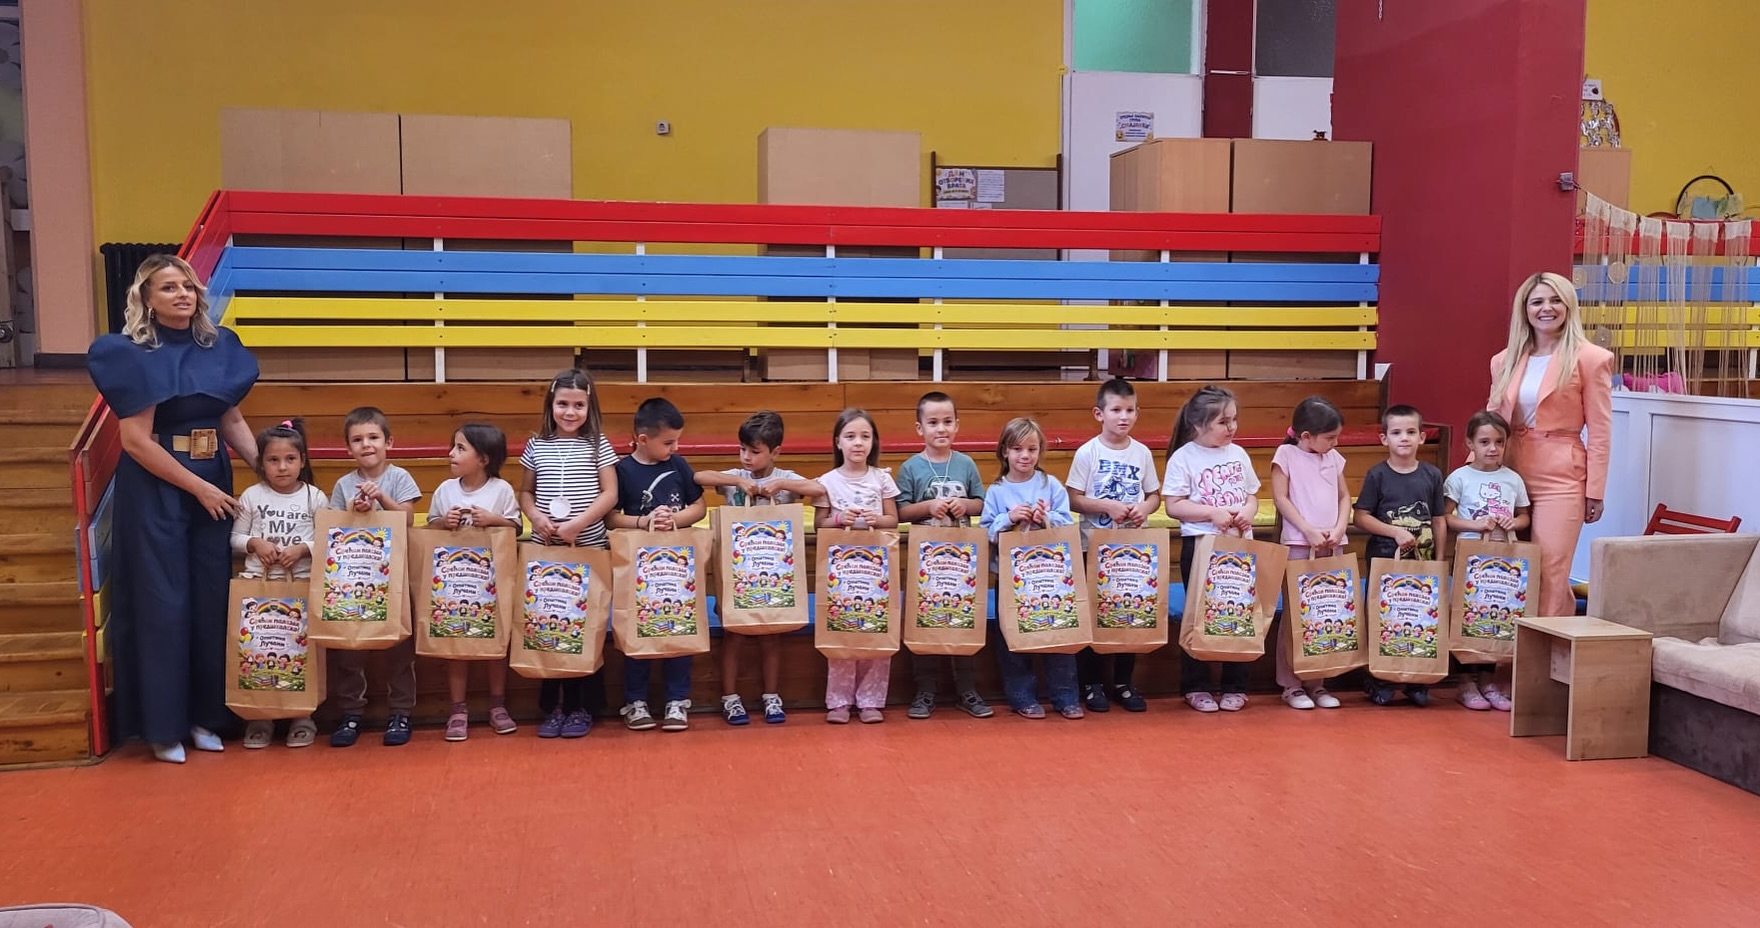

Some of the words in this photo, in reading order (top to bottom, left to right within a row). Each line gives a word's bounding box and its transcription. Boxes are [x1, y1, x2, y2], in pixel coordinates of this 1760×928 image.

[1098, 459, 1140, 480] BMX
[287, 511, 308, 520] are
[269, 520, 297, 534] My
